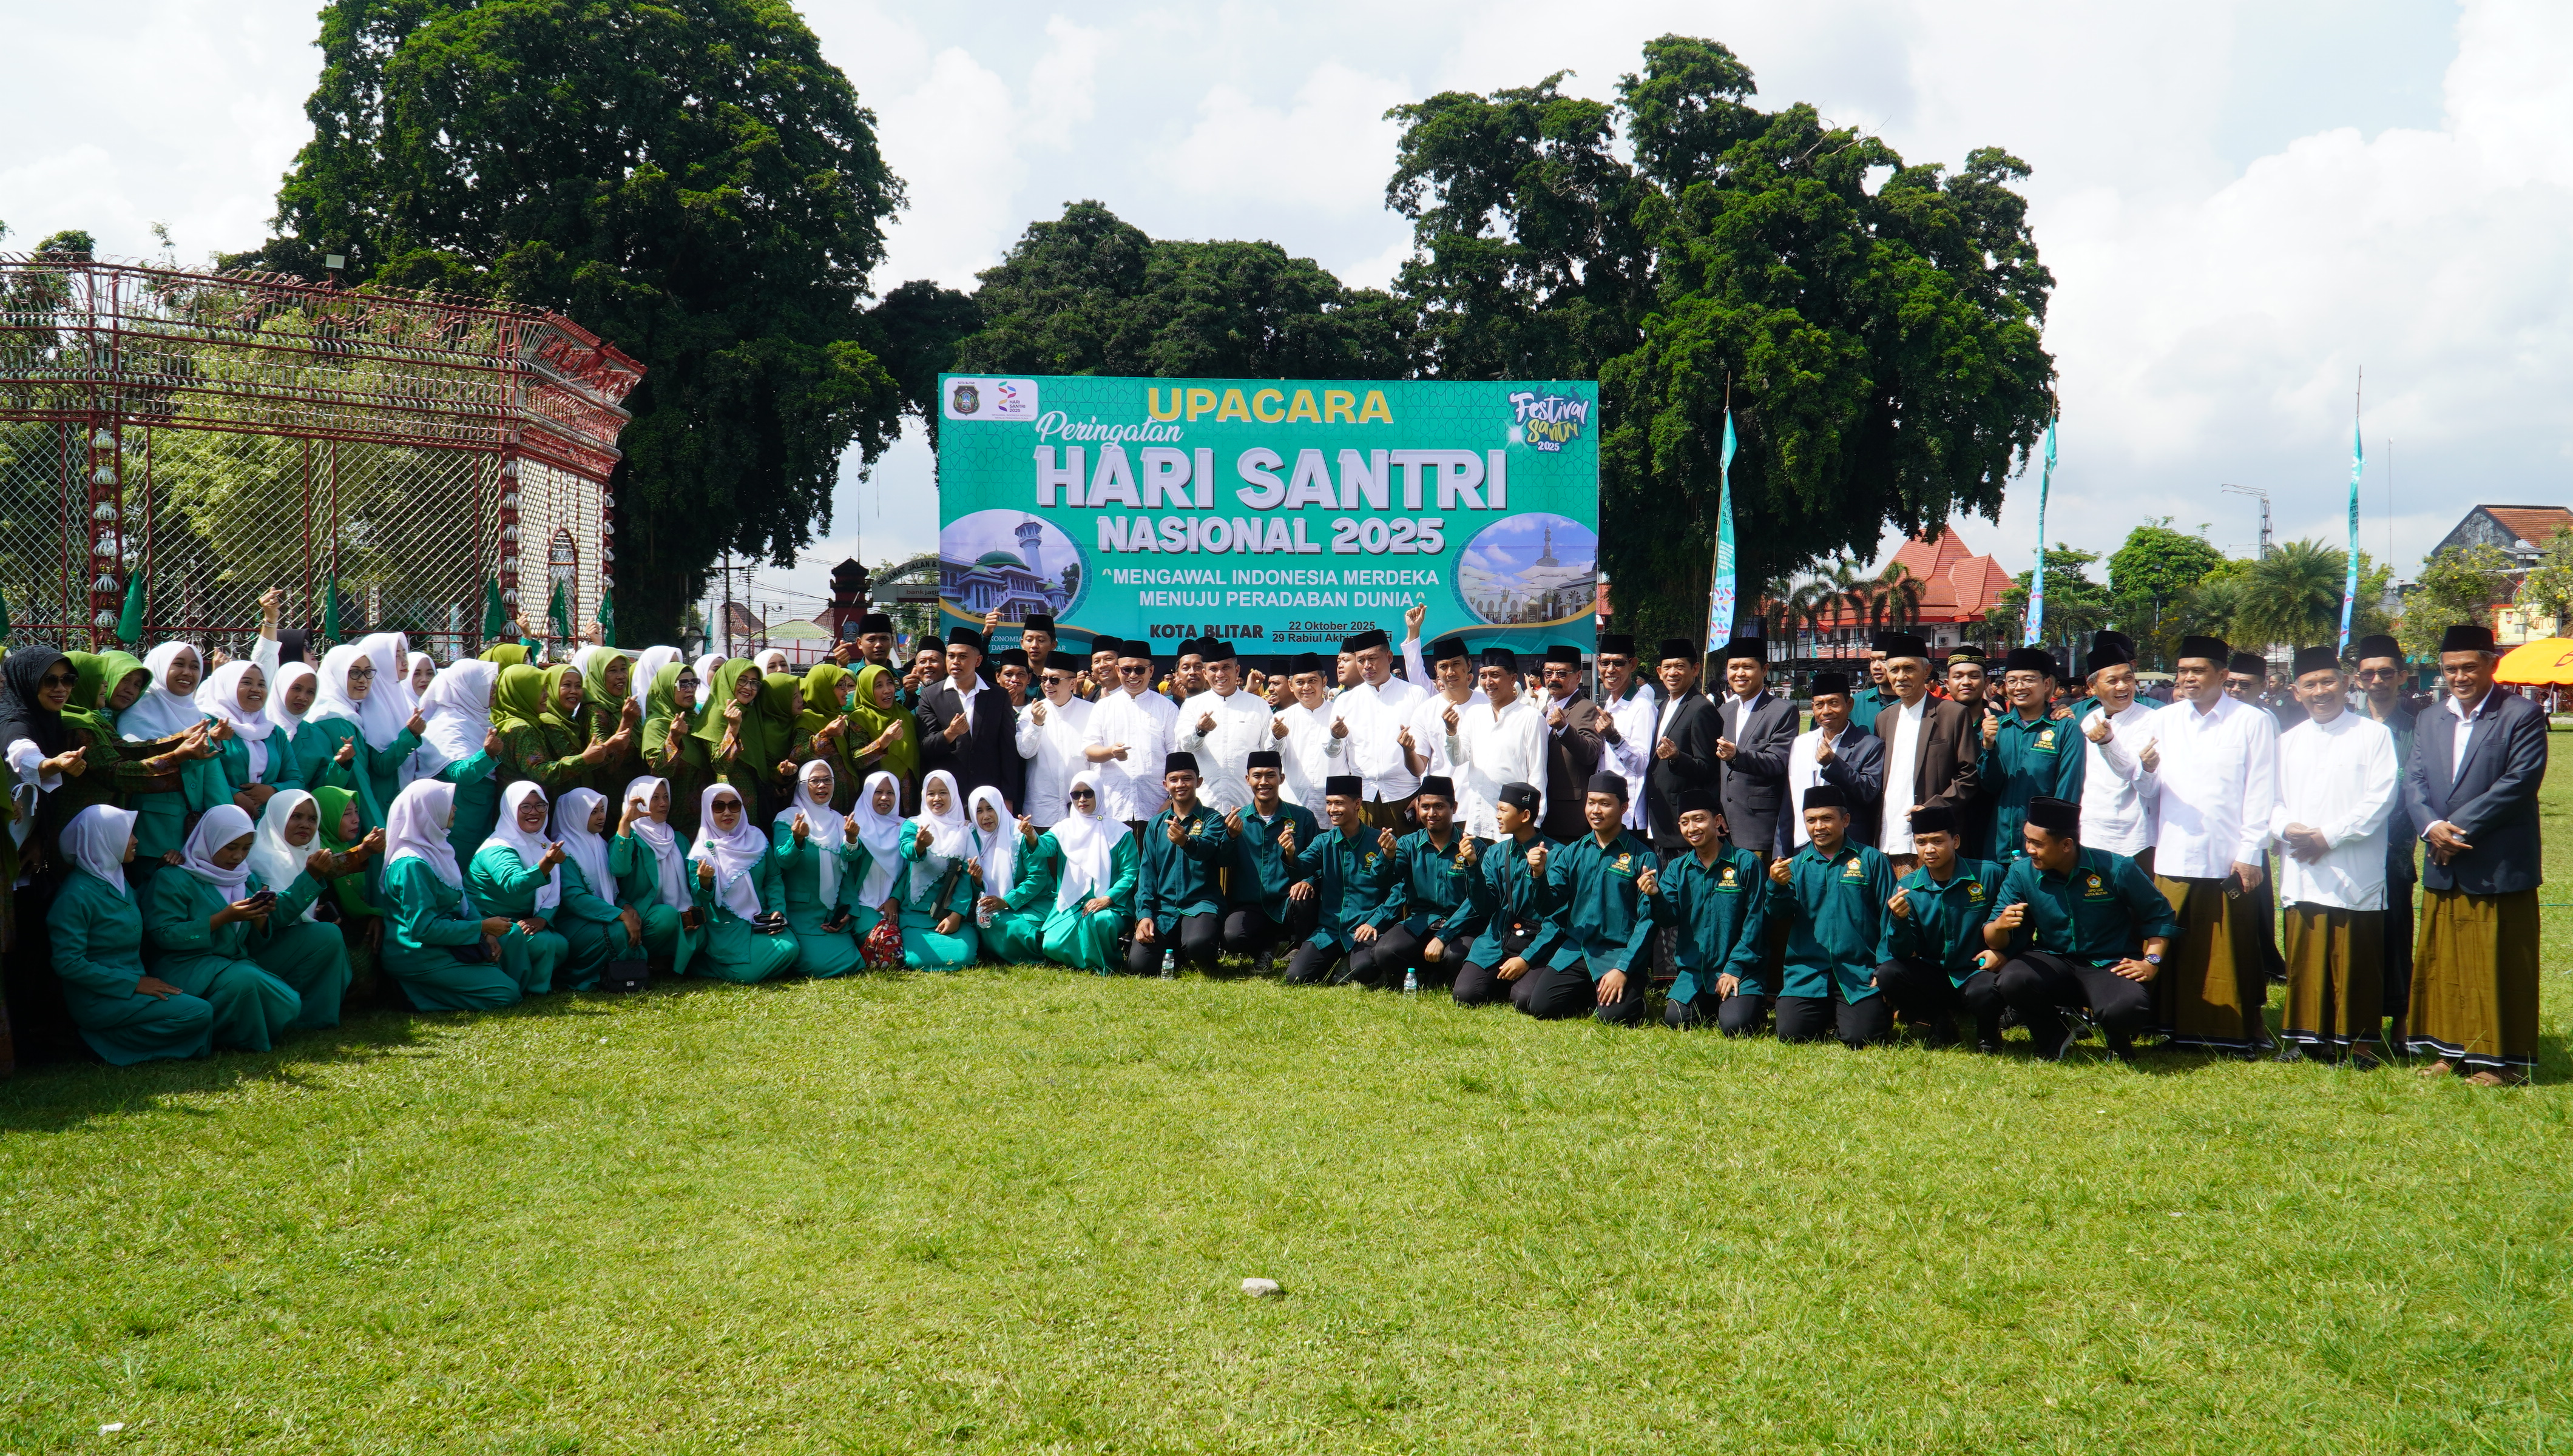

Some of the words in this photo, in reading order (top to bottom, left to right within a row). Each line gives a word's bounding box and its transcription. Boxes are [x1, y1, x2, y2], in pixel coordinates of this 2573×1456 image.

[1148, 388, 1393, 423] UPACARA
[1510, 392, 1589, 424] Festival
[1035, 411, 1184, 453] Peringatan
[1537, 441, 1560, 451] 2025
[1033, 445, 1215, 510] HARI
[1236, 447, 1508, 511] SANTRI
[1097, 516, 1323, 554] NASIONAL
[1331, 517, 1446, 555] 2025
[877, 567, 905, 587] SELAMAT
[908, 561, 930, 571] JALAN
[1232, 569, 1337, 585] INDONESIA
[1342, 570, 1439, 585] MERDEKA
[1140, 592, 1220, 607] MENUJU
[1226, 592, 1348, 607] PERADABAN
[1150, 624, 1197, 638] KOTA
[1204, 624, 1264, 638] BLITAR
[1289, 621, 1301, 630] 22
[1304, 621, 1348, 630] Oktober
[1350, 621, 1376, 630] 2025
[1272, 633, 1285, 642] 29
[1288, 633, 1322, 642] Rabiul
